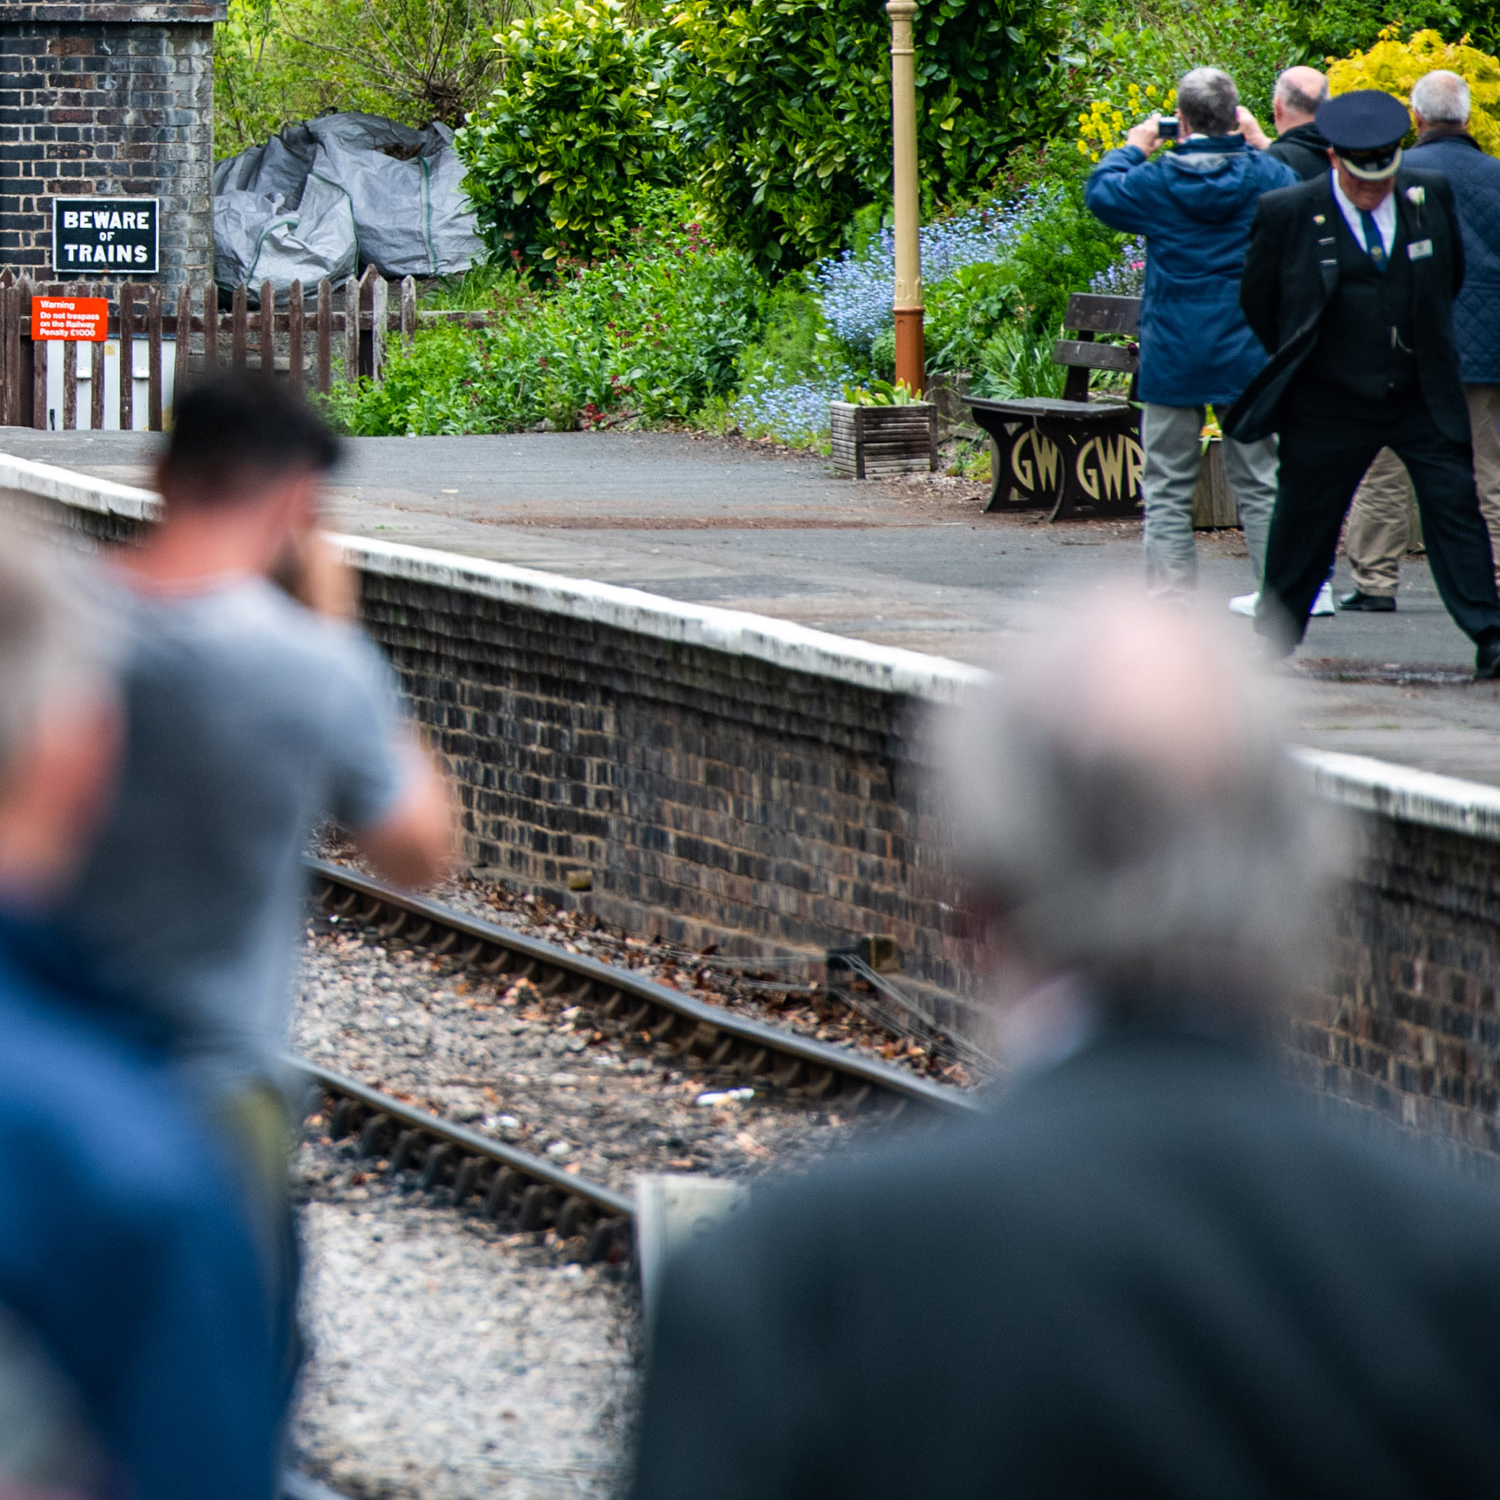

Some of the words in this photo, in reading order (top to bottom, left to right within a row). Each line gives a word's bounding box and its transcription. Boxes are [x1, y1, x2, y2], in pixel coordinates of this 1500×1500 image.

[63, 211, 149, 229] BEWARE
[99, 232, 115, 241] OF
[64, 244, 148, 263] TRAINS
[40, 300, 75, 310] Warning
[40, 311, 51, 319] Do
[67, 313, 100, 321] trespass
[52, 320, 64, 328] the
[66, 320, 95, 329] Railway
[40, 328, 68, 337] Penalty
[70, 329, 95, 337] £1000
[1011, 427, 1058, 492] GW
[1076, 434, 1145, 500] GWR
